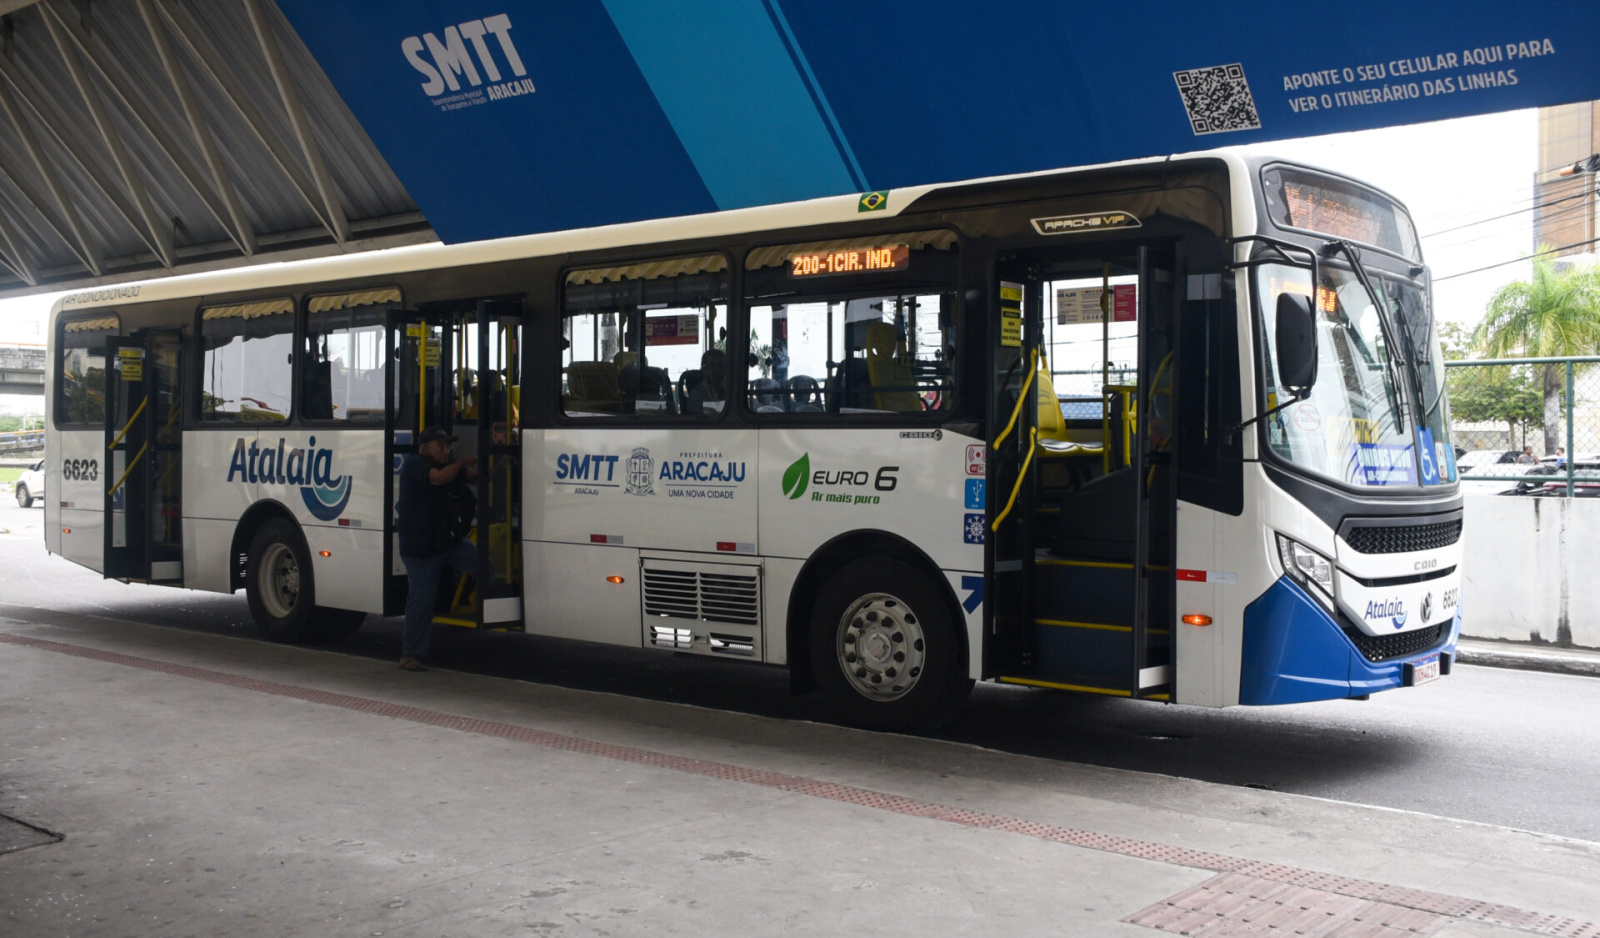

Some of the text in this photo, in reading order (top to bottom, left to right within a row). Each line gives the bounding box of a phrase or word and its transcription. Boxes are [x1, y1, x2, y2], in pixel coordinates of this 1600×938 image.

[401, 13, 527, 97] SMTT
[1283, 37, 1555, 92] APONTE O SEU CELULAR AQUI PARA
[486, 78, 536, 101] ARACAJU
[1288, 68, 1519, 114] VER O ITINERÁRIO DAS LINHAS
[1044, 215, 1125, 230] APACHE VIP
[63, 459, 98, 482] 6623
[227, 434, 342, 488] Atalaia
[555, 453, 619, 481] SMTT
[659, 461, 746, 482] ARACAJU
[812, 466, 900, 492] EURO 6
[574, 487, 600, 496] ARACAJU
[668, 488, 735, 499] UMA NOVA CIDADE
[811, 491, 880, 505] Ar mais puro
[1364, 596, 1405, 621] Atalaia
